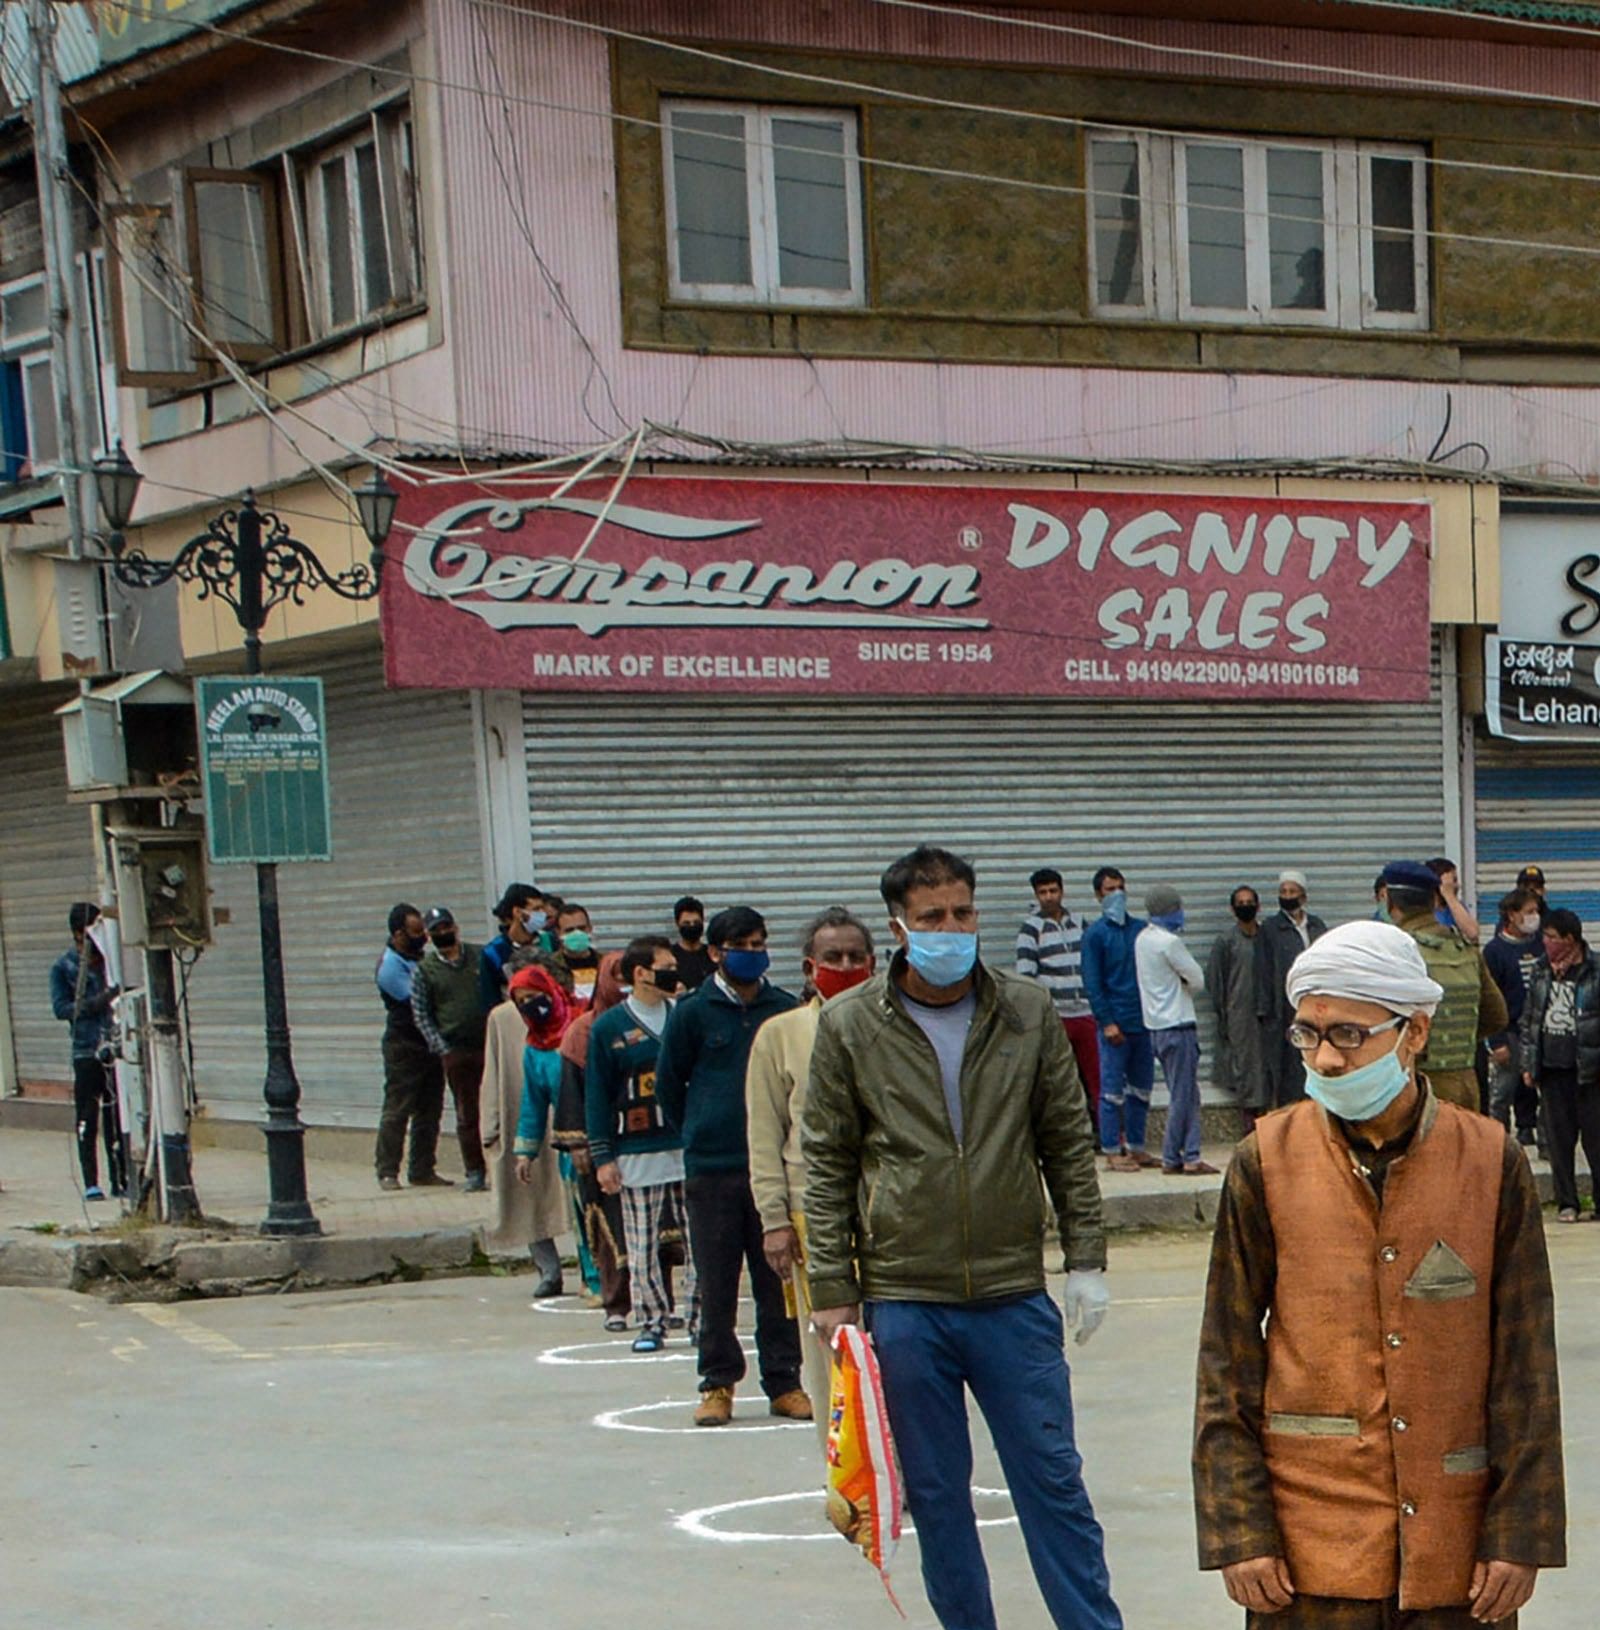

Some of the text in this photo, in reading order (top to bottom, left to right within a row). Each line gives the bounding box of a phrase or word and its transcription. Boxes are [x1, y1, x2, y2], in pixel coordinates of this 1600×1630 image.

[1006, 503, 1413, 588] DIGNITY
[403, 498, 988, 635] Companion
[1097, 587, 1330, 655] SALES
[533, 653, 831, 680] MARK OF EXCELLENCE
[858, 643, 993, 663] SINCE 1954
[1065, 659, 1120, 682] CELL.
[1504, 643, 1574, 674] SAGA
[206, 686, 318, 733] NEELAM AUTO STAND
